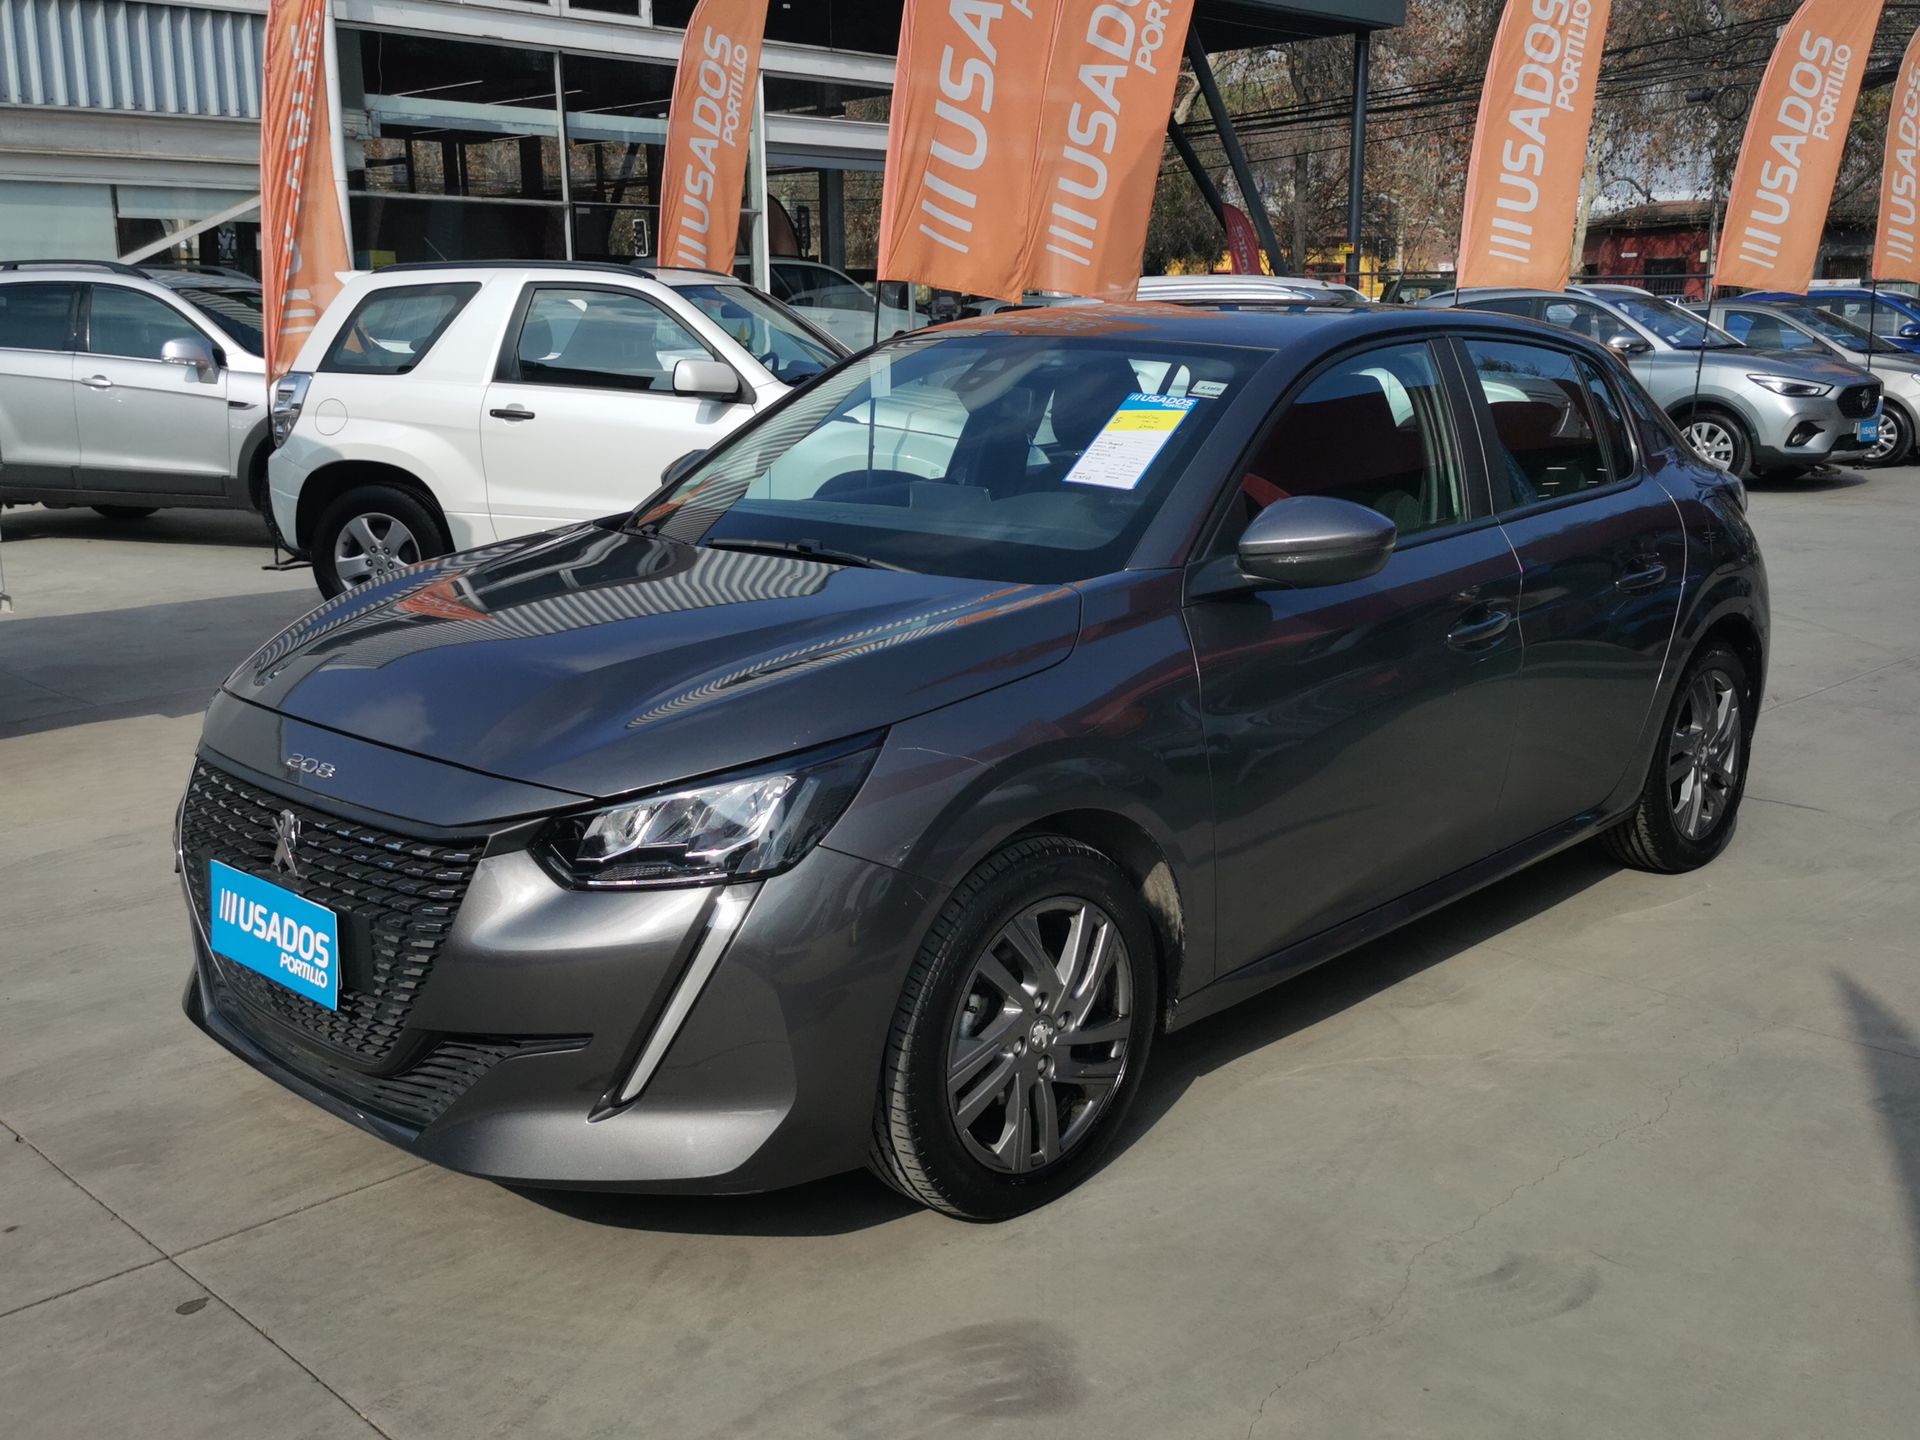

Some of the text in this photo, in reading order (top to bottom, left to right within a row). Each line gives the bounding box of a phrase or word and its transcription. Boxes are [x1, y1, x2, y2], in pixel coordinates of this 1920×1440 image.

[1134, 0, 1174, 75] POR
[1556, 0, 1592, 112] PORTILLO
[681, 25, 733, 234] USADOS
[722, 44, 748, 147] PORTILLO
[1057, 0, 1144, 201] USAD
[1496, 0, 1571, 213] USADOS
[1750, 30, 1834, 225] USADOS
[1812, 44, 1851, 141] PORTILLO
[1889, 62, 1920, 226] USADOS
[1141, 394, 1195, 408] USADOS
[285, 753, 336, 779] 208
[238, 896, 331, 969] USADOS
[279, 952, 329, 989] PORTILLO
